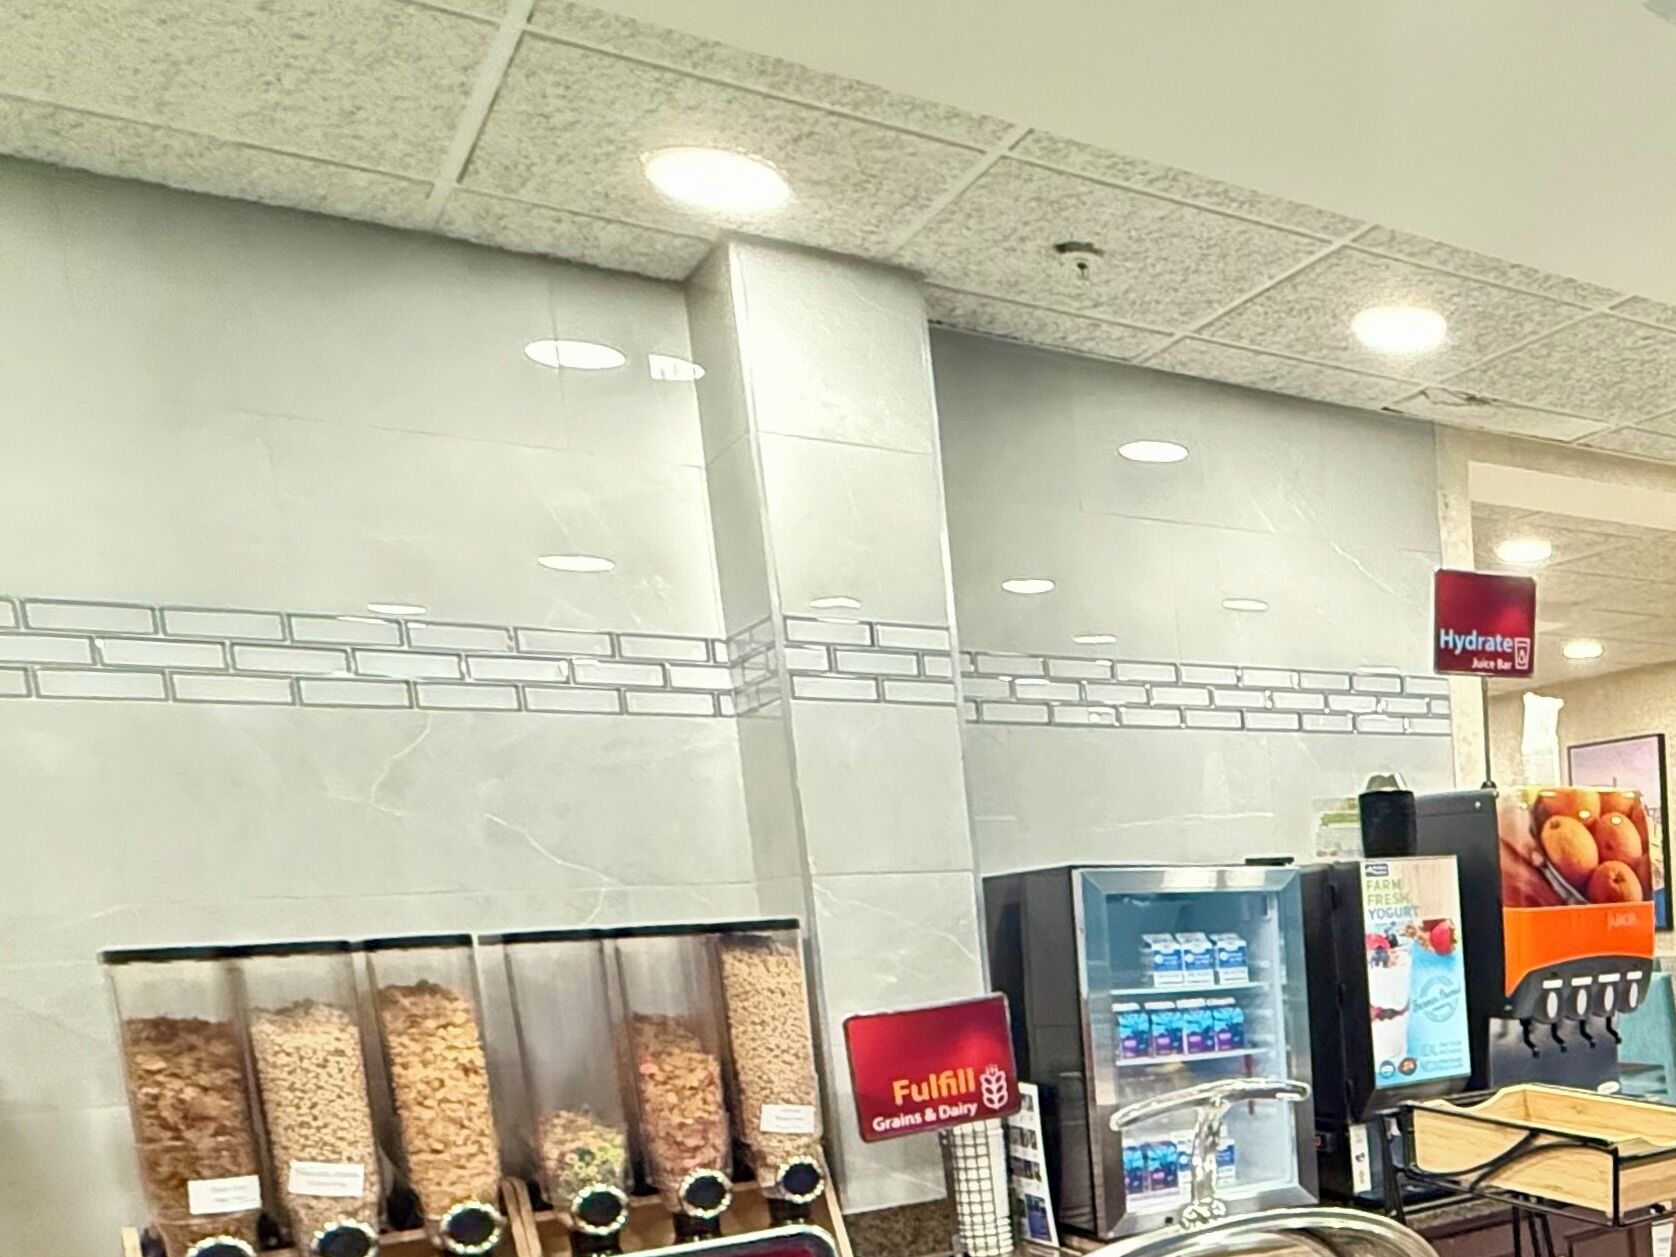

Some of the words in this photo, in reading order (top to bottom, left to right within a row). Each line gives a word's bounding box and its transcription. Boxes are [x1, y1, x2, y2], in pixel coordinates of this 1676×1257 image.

[1440, 628, 1513, 655] Hydrate
[1472, 657, 1495, 669] Juice
[1497, 658, 1512, 670] Bar
[1366, 879, 1404, 892] FARM
[1367, 892, 1411, 906] FRESH
[1367, 905, 1419, 921] YOGURT
[893, 1067, 976, 1106] Fulfill
[872, 1112, 922, 1132] Grains
[924, 1107, 937, 1122] &
[938, 1102, 978, 1120] Dairy
